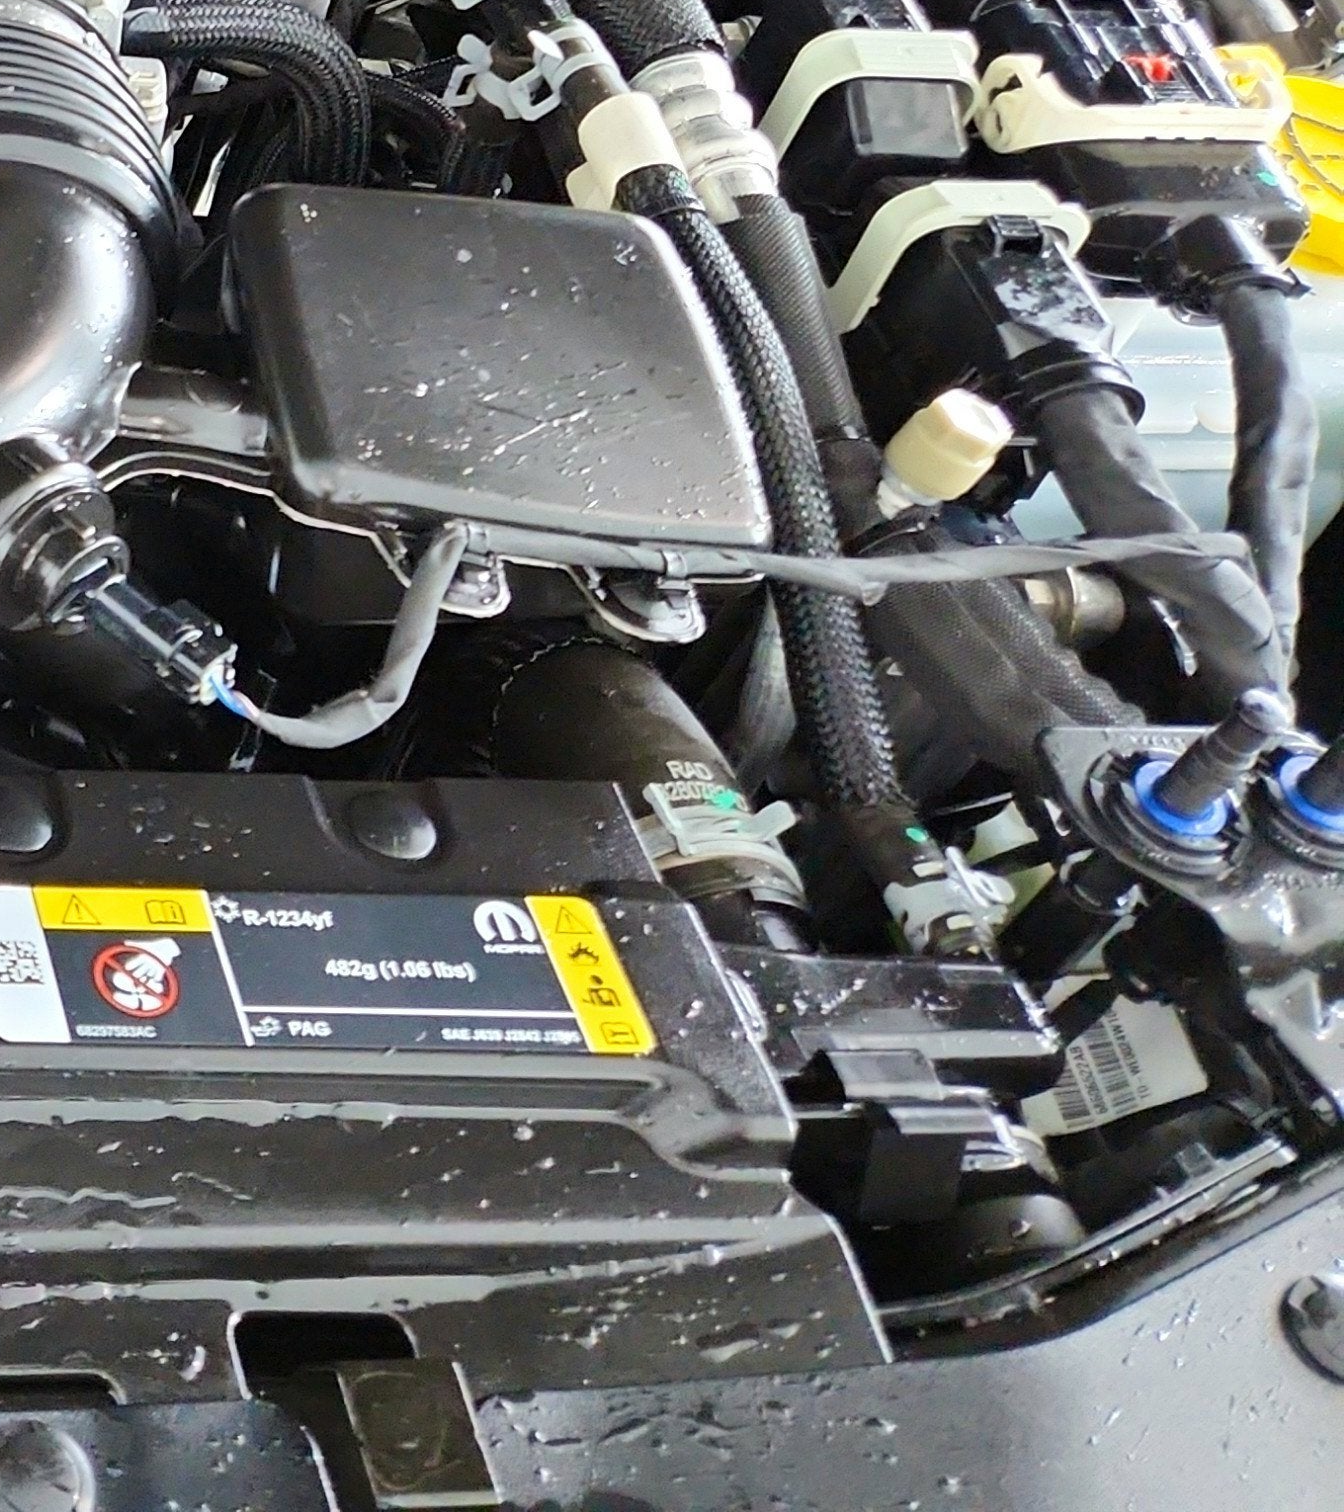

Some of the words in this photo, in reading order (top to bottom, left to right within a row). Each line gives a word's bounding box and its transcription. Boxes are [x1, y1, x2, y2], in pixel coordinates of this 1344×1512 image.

[666, 760, 713, 781] RAD
[243, 909, 334, 931] R-1234yf
[484, 944, 544, 954] MOPAR
[325, 959, 377, 981] 482g
[380, 960, 431, 981] (1.06
[434, 961, 476, 982] lbs)
[287, 1021, 332, 1037] PAG
[441, 1028, 471, 1041] SAE
